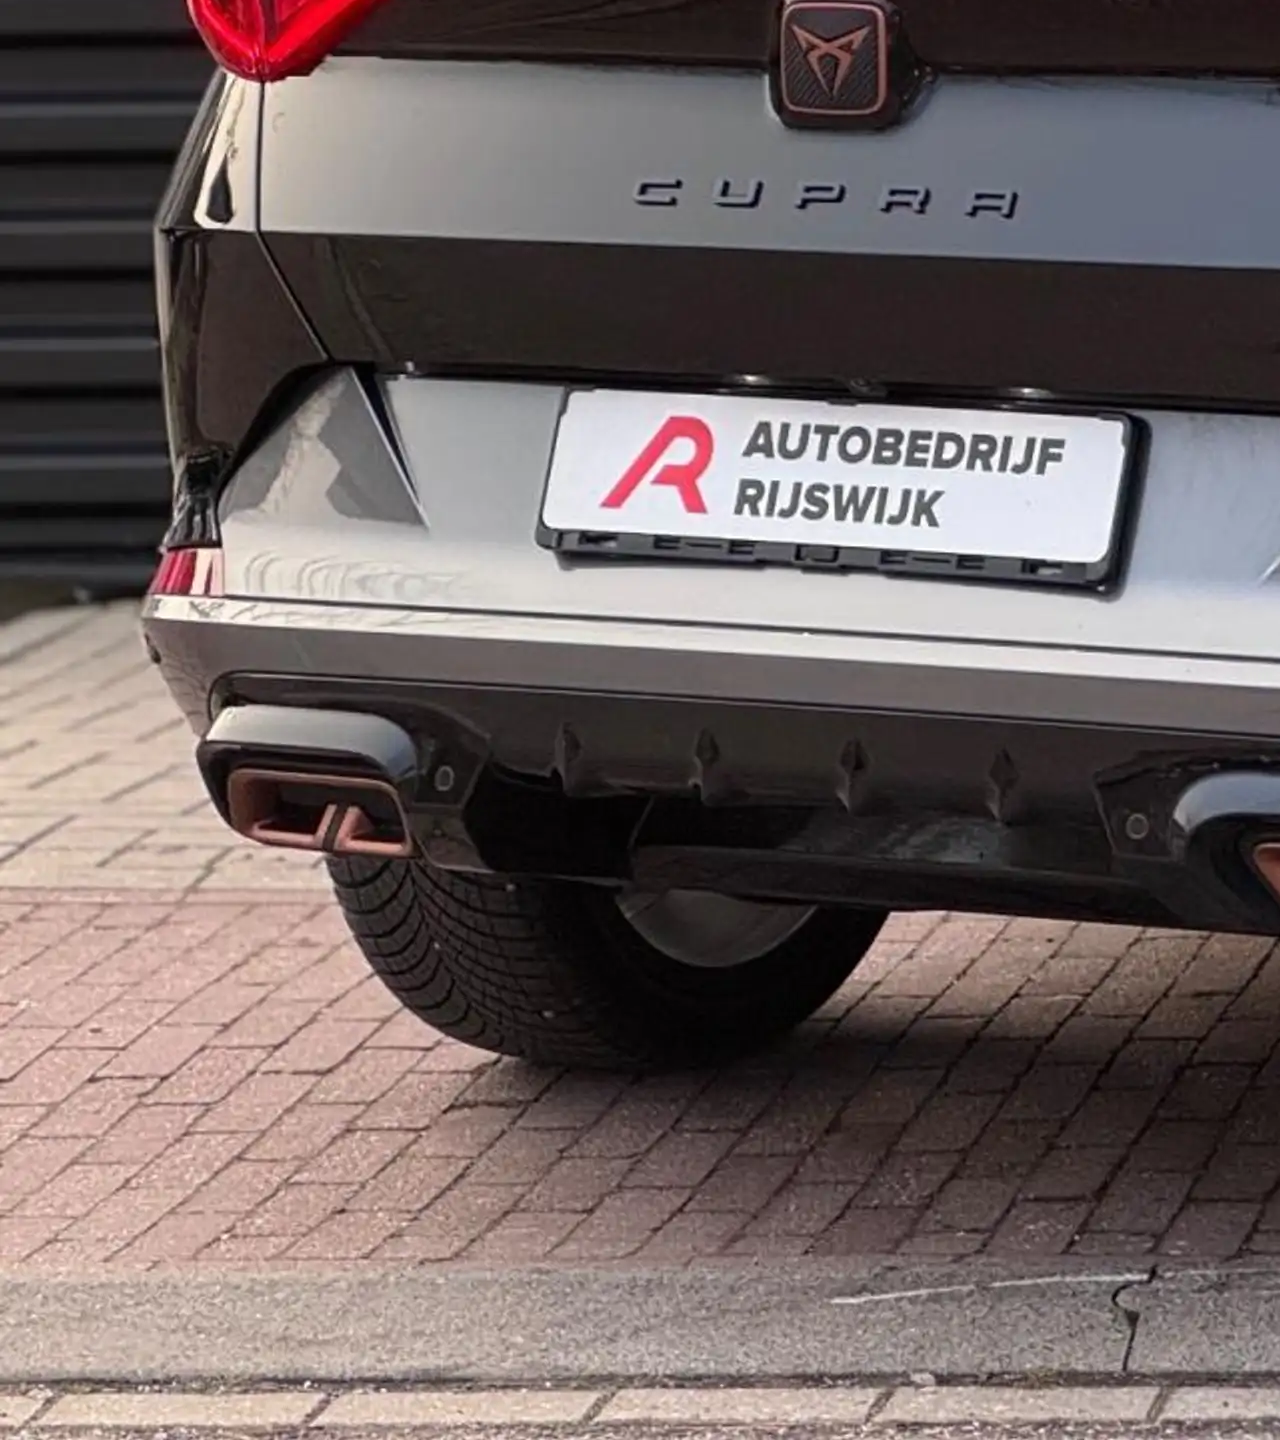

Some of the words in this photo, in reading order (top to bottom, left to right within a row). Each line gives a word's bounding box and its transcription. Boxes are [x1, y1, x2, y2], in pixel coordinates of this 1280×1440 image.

[633, 177, 1021, 221] CUPRA
[741, 420, 1066, 477] AUTOBEDRIJF
[732, 477, 946, 529] RIJSWIJK
